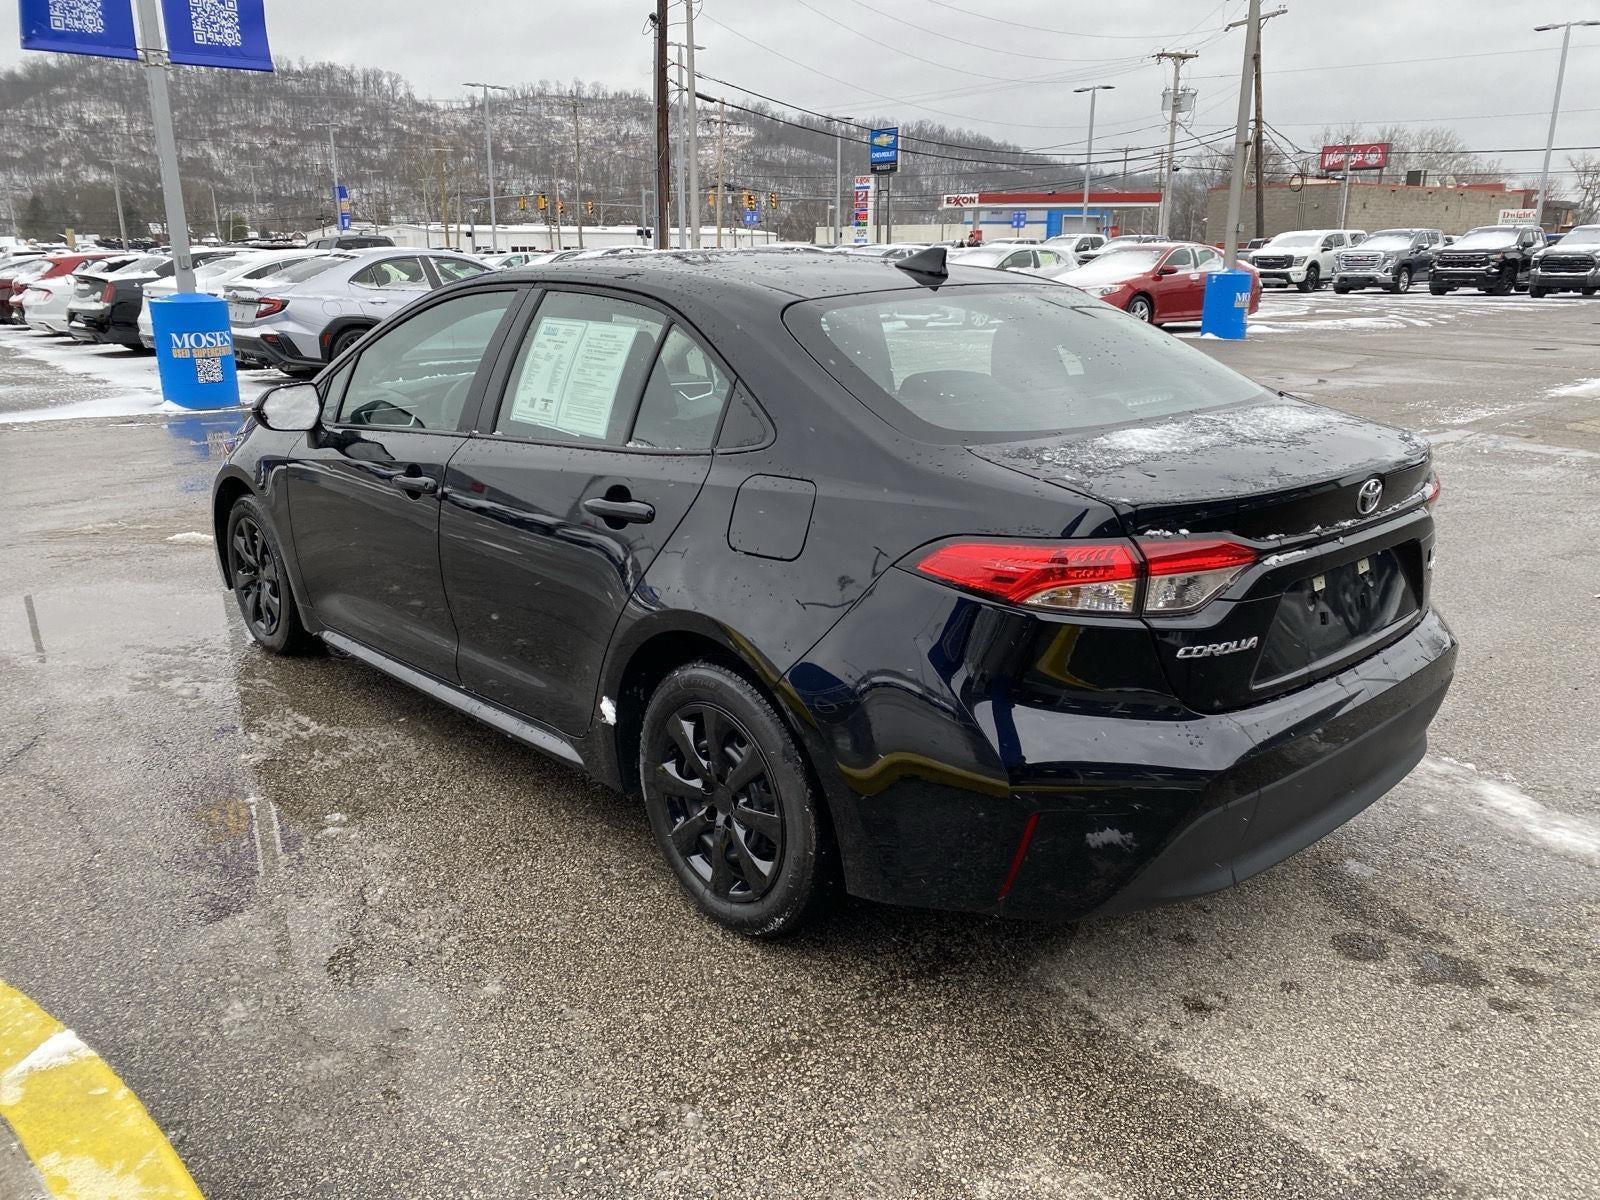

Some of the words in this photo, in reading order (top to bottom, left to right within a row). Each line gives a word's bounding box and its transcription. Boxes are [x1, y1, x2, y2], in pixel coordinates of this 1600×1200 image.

[871, 151, 895, 159] CHEVROLET
[946, 195, 976, 207] EXXON
[170, 331, 231, 348] MOSES
[172, 348, 190, 358] USED
[1176, 636, 1259, 658] COROLLA
